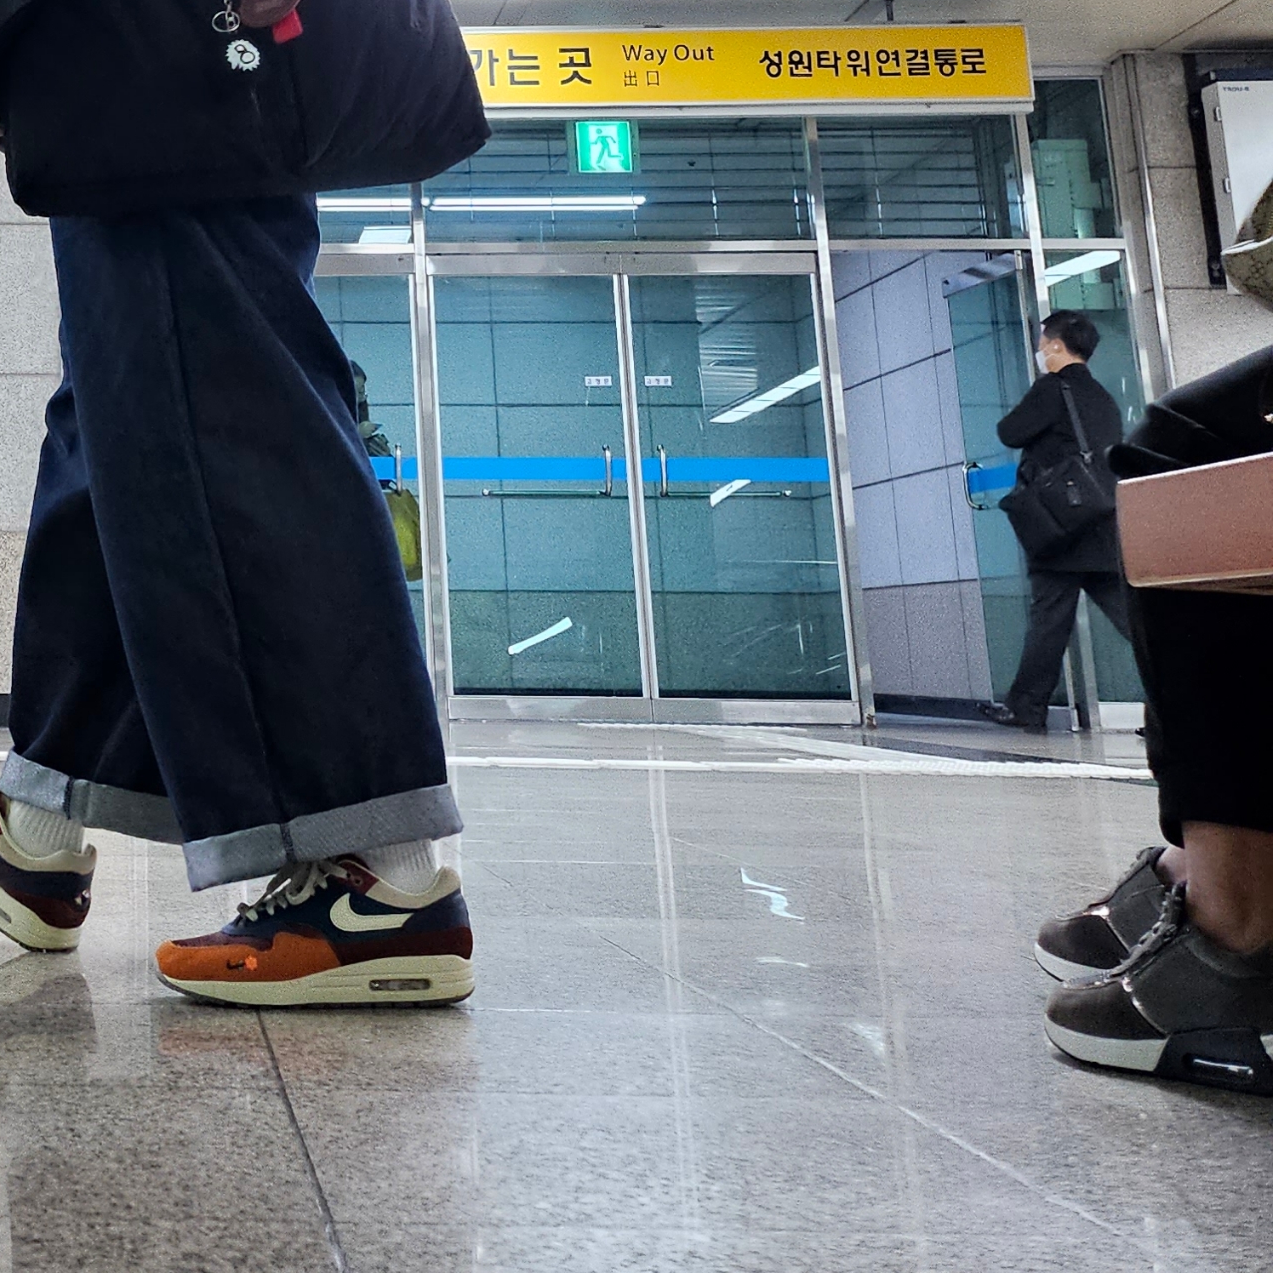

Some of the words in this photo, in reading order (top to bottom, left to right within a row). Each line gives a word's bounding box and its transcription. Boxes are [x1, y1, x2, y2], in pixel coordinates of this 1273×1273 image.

[558, 47, 592, 85] 곳
[622, 44, 668, 66] Way
[673, 44, 715, 61] Out
[759, 48, 987, 78] 성원타워연결통로
[623, 70, 660, 87] 出口
